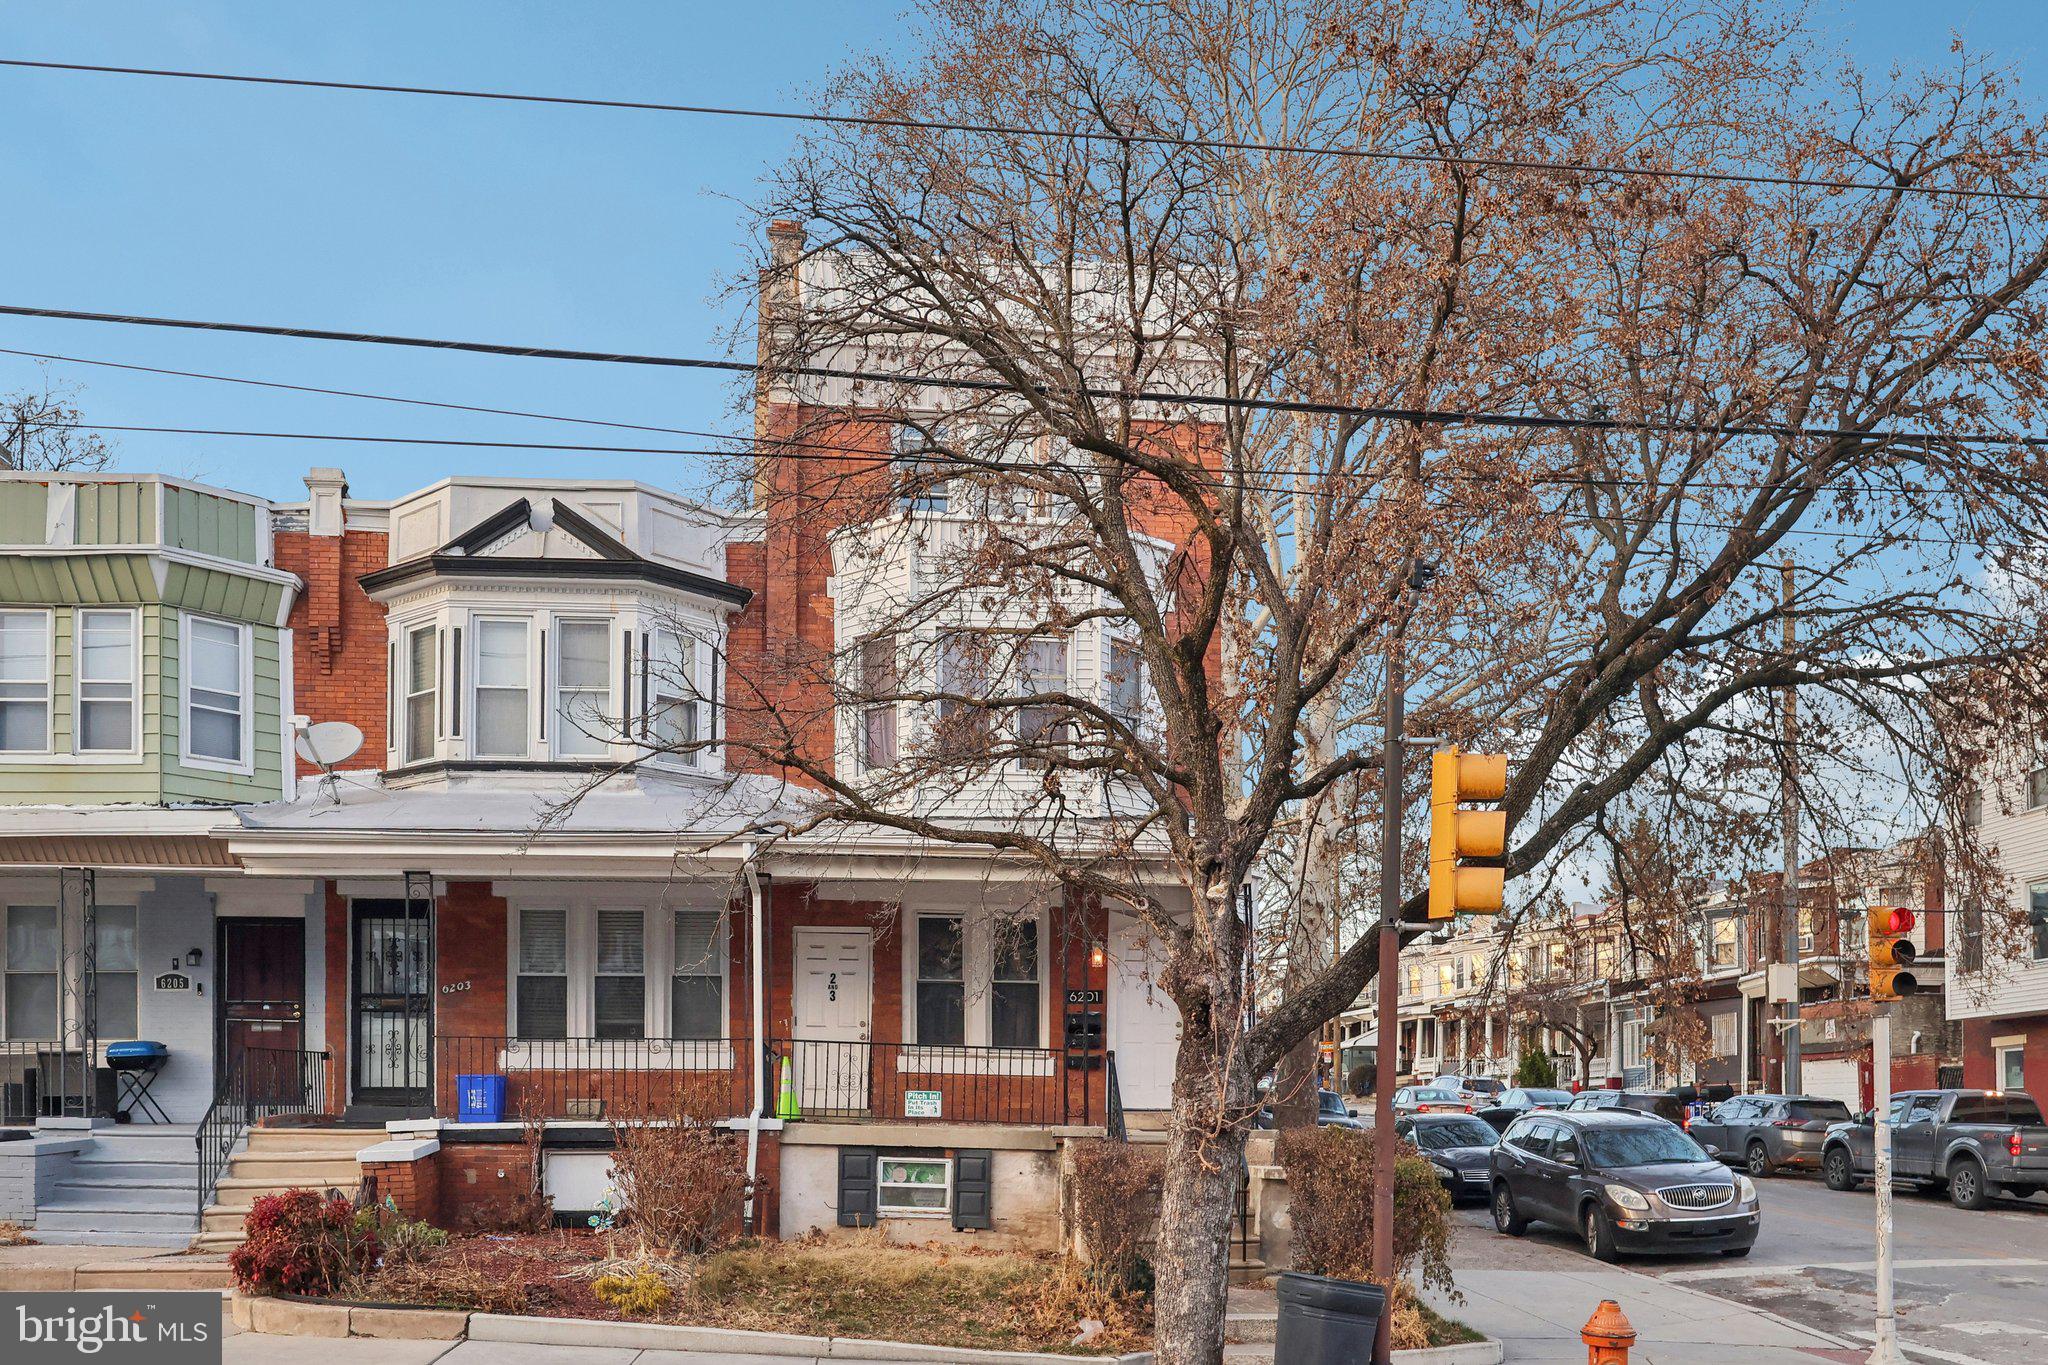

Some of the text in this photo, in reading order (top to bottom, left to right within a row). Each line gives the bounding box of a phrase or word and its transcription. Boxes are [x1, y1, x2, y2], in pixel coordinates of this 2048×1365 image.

[161, 978, 184, 989] 6205
[830, 973, 836, 984] 2
[442, 981, 471, 993] 6203
[830, 991, 836, 1001] 3
[1069, 992, 1099, 1002] 6201
[930, 1092, 939, 1100] In!
